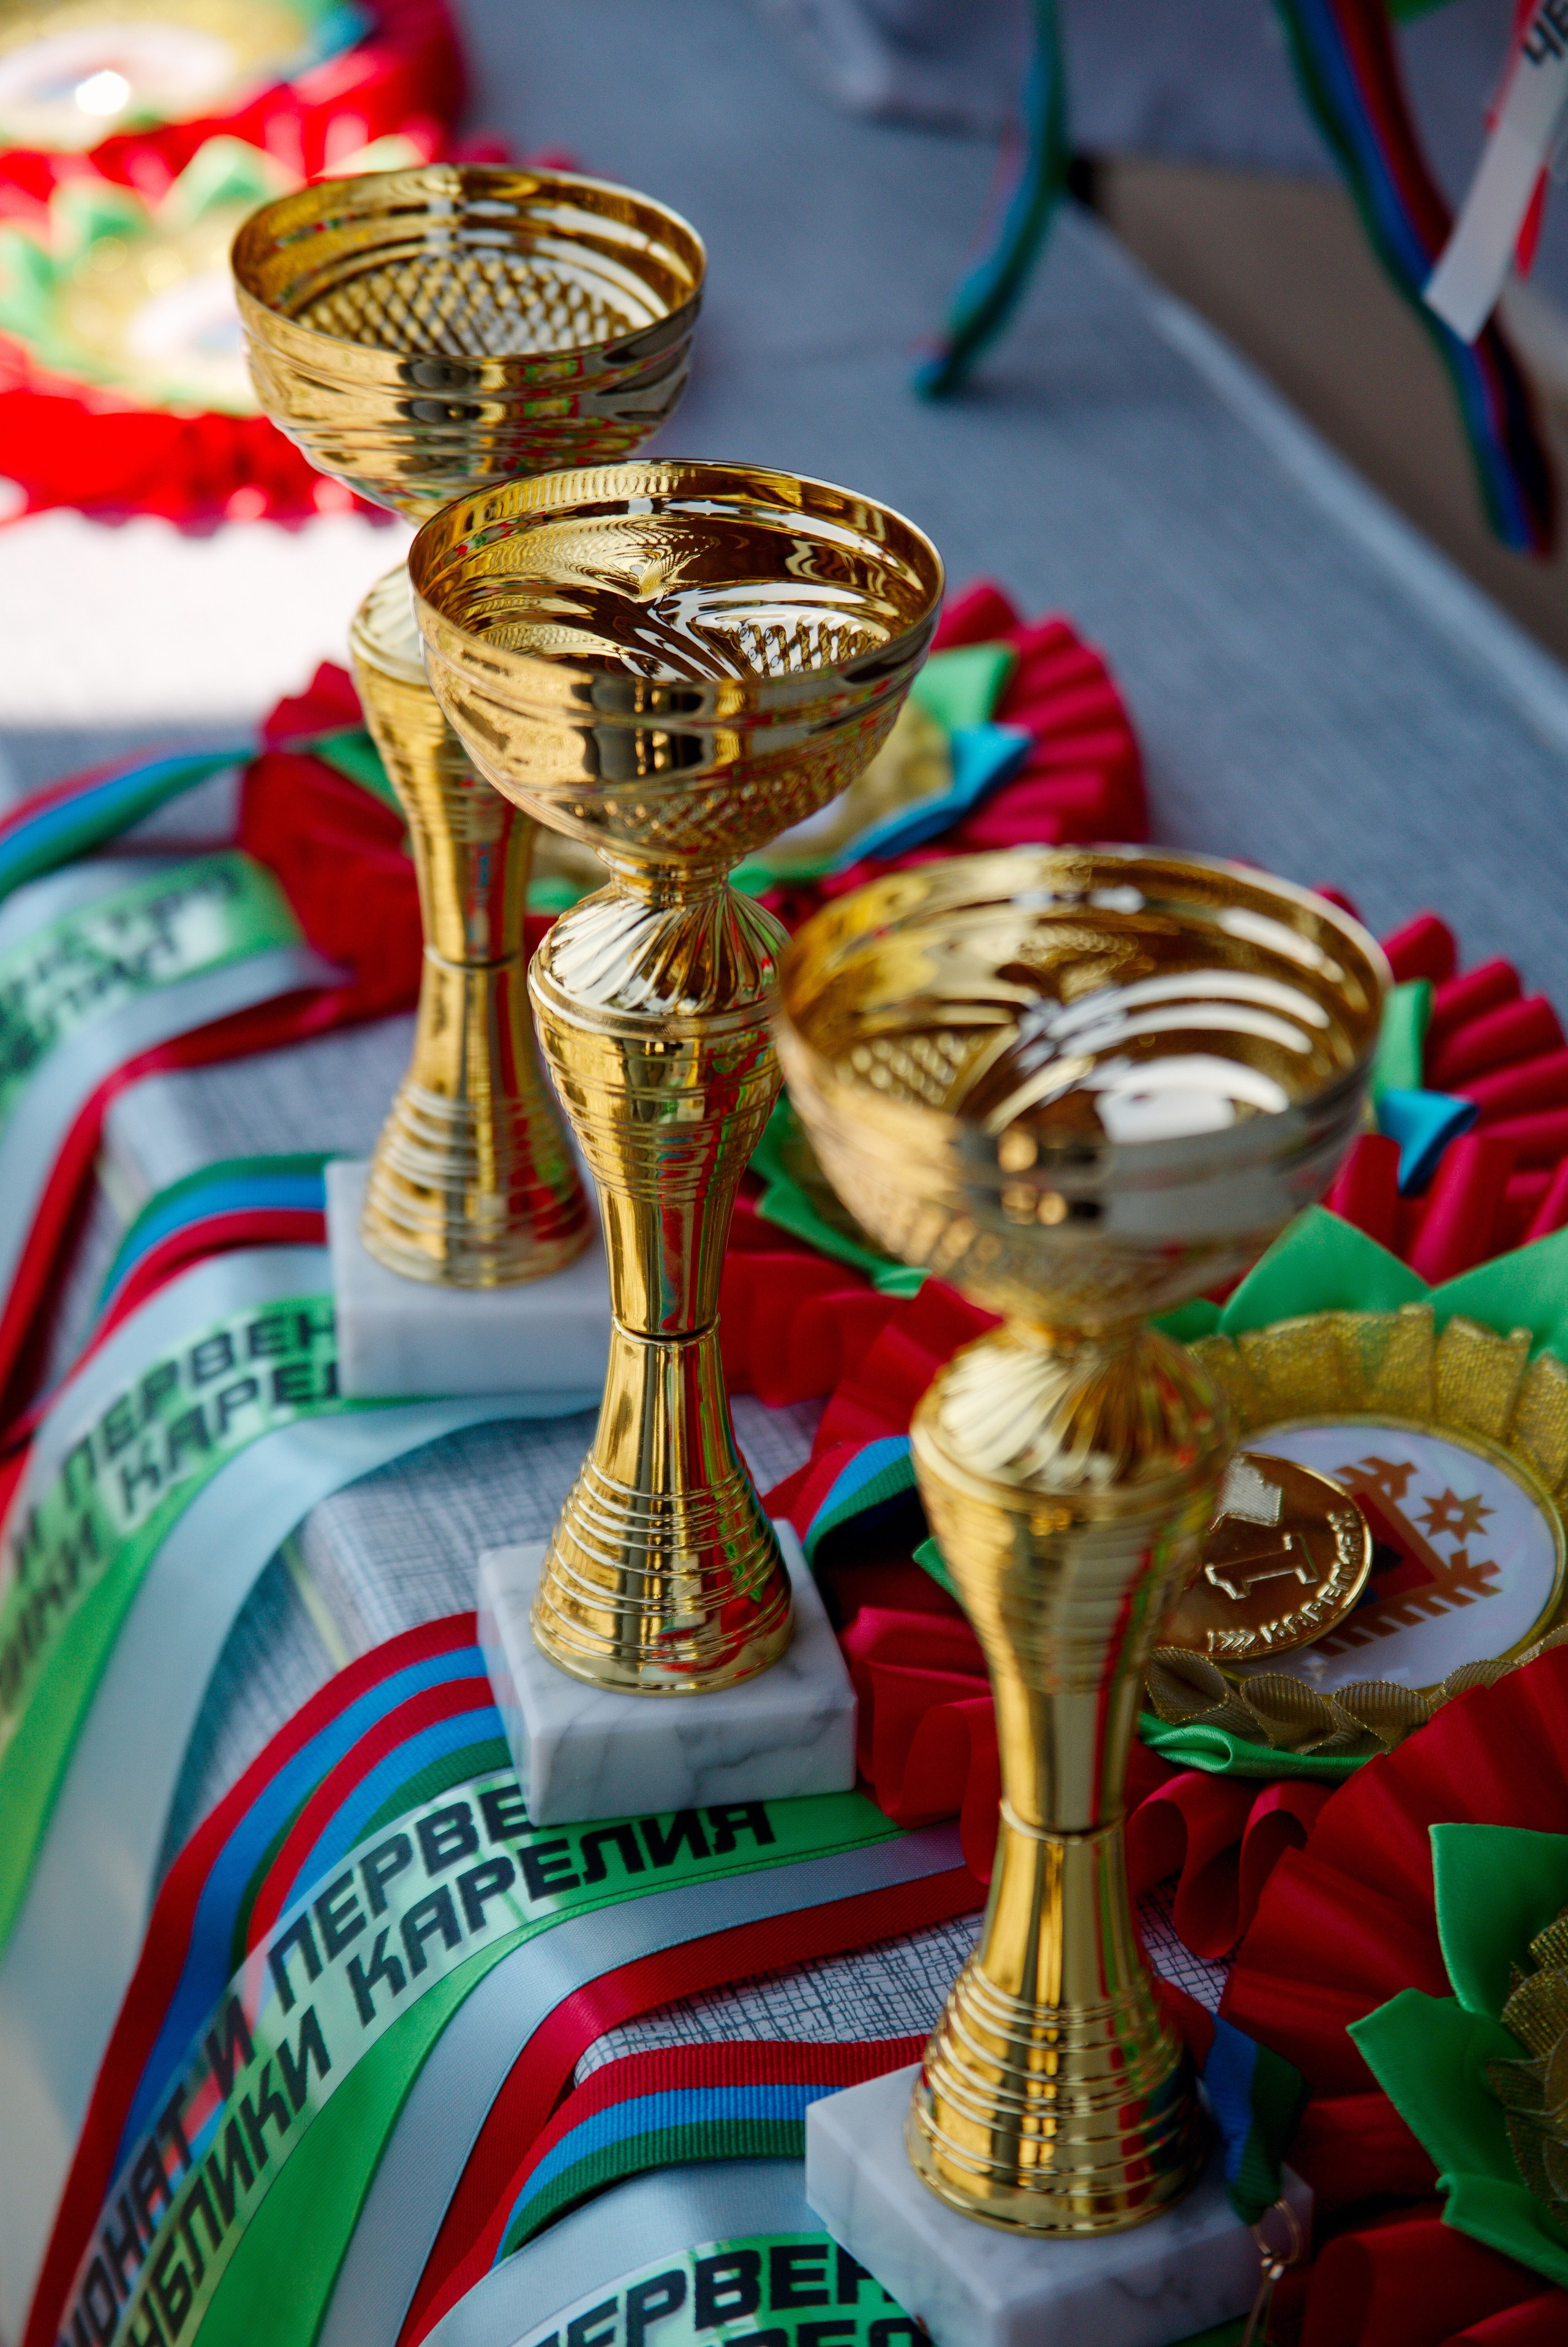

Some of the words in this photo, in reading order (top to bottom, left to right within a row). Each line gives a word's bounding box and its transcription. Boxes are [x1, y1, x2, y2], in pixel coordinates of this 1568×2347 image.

[1204, 1532, 1319, 1600] 1
[205, 1995, 255, 2103] И
[267, 1784, 562, 2015] ПЕРВЕ
[345, 1802, 776, 2030] КАРЕЛИЯ
